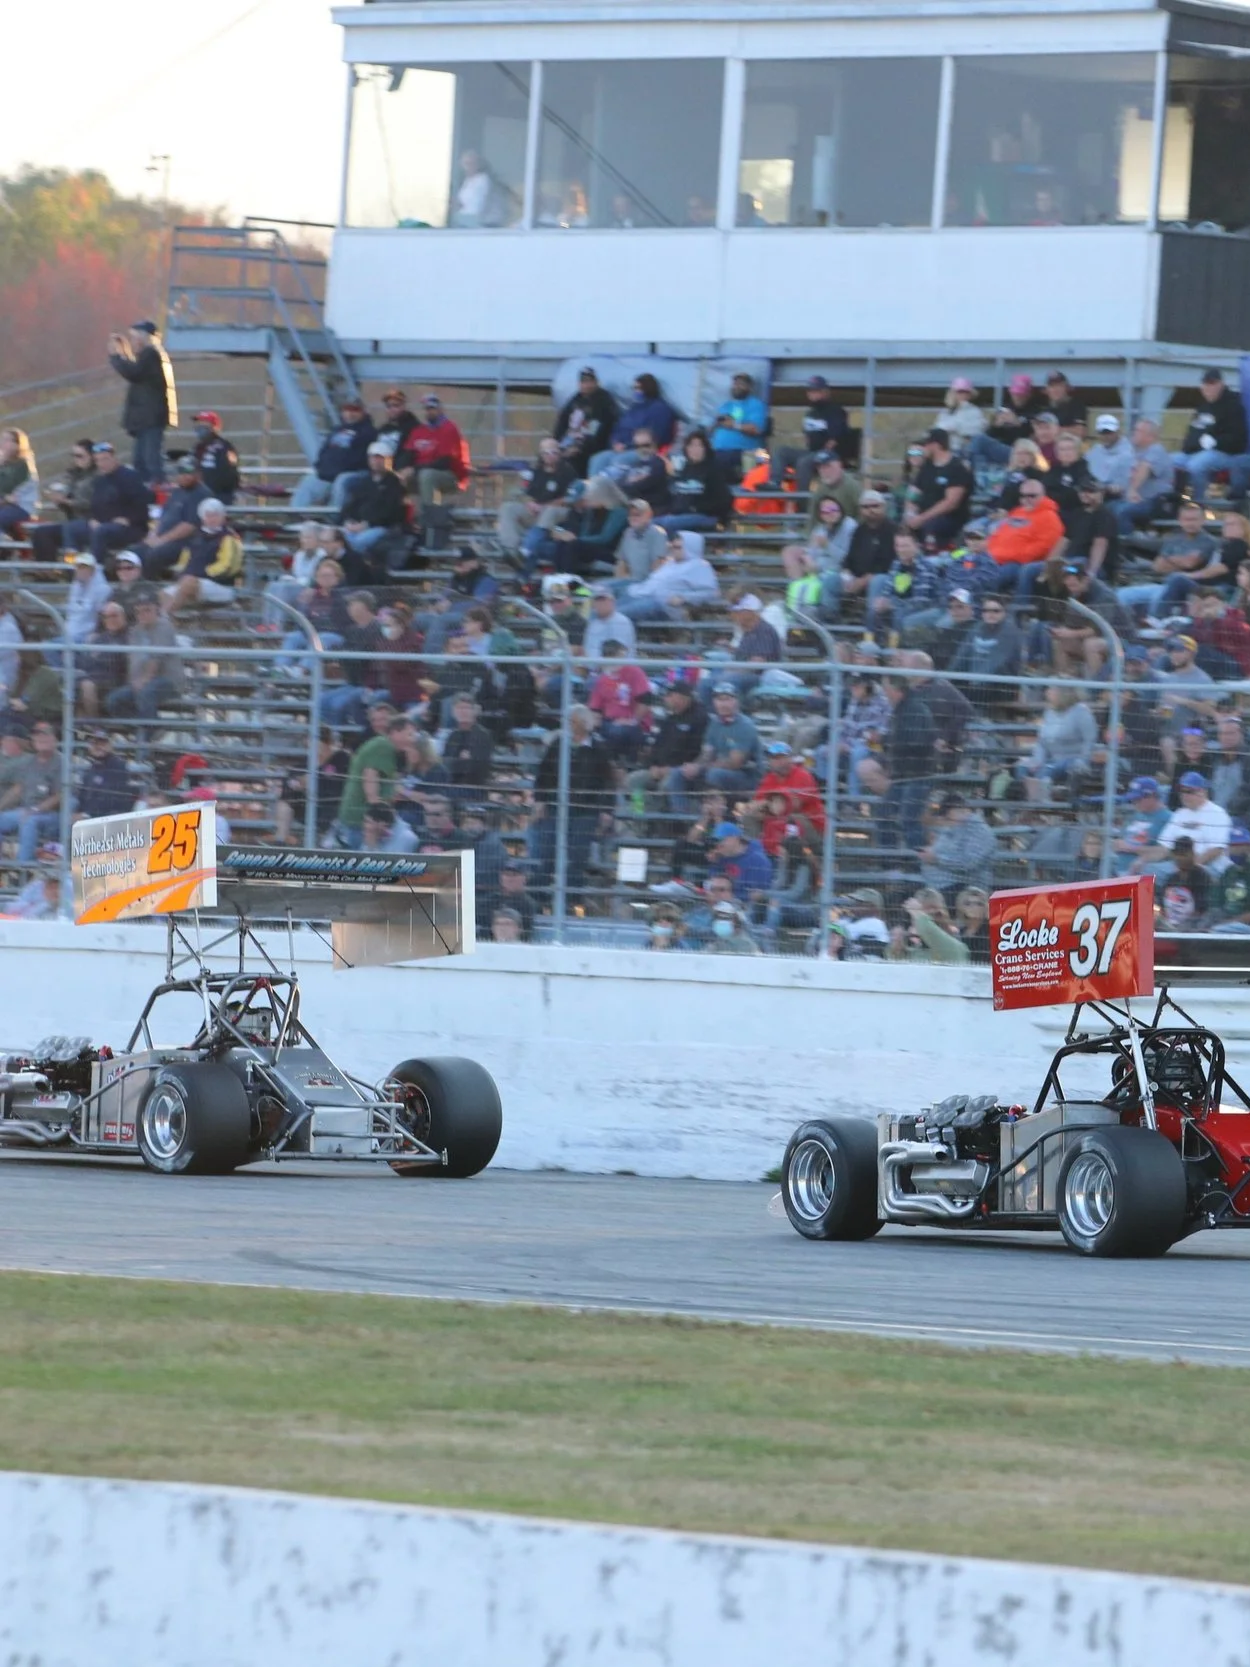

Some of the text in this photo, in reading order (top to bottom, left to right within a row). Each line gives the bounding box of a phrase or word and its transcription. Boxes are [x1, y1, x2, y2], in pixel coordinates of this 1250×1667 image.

[73, 830, 145, 858] Northeast Metals
[147, 810, 201, 875] 25
[81, 857, 137, 880] Technologies
[224, 850, 284, 868] General
[279, 853, 345, 871] Products
[343, 857, 357, 871] &
[355, 857, 392, 873] Gear
[998, 918, 1059, 951] Locke
[1069, 897, 1132, 979] 37
[995, 948, 1065, 965] Crane Services
[998, 969, 1063, 982] Serving New England
